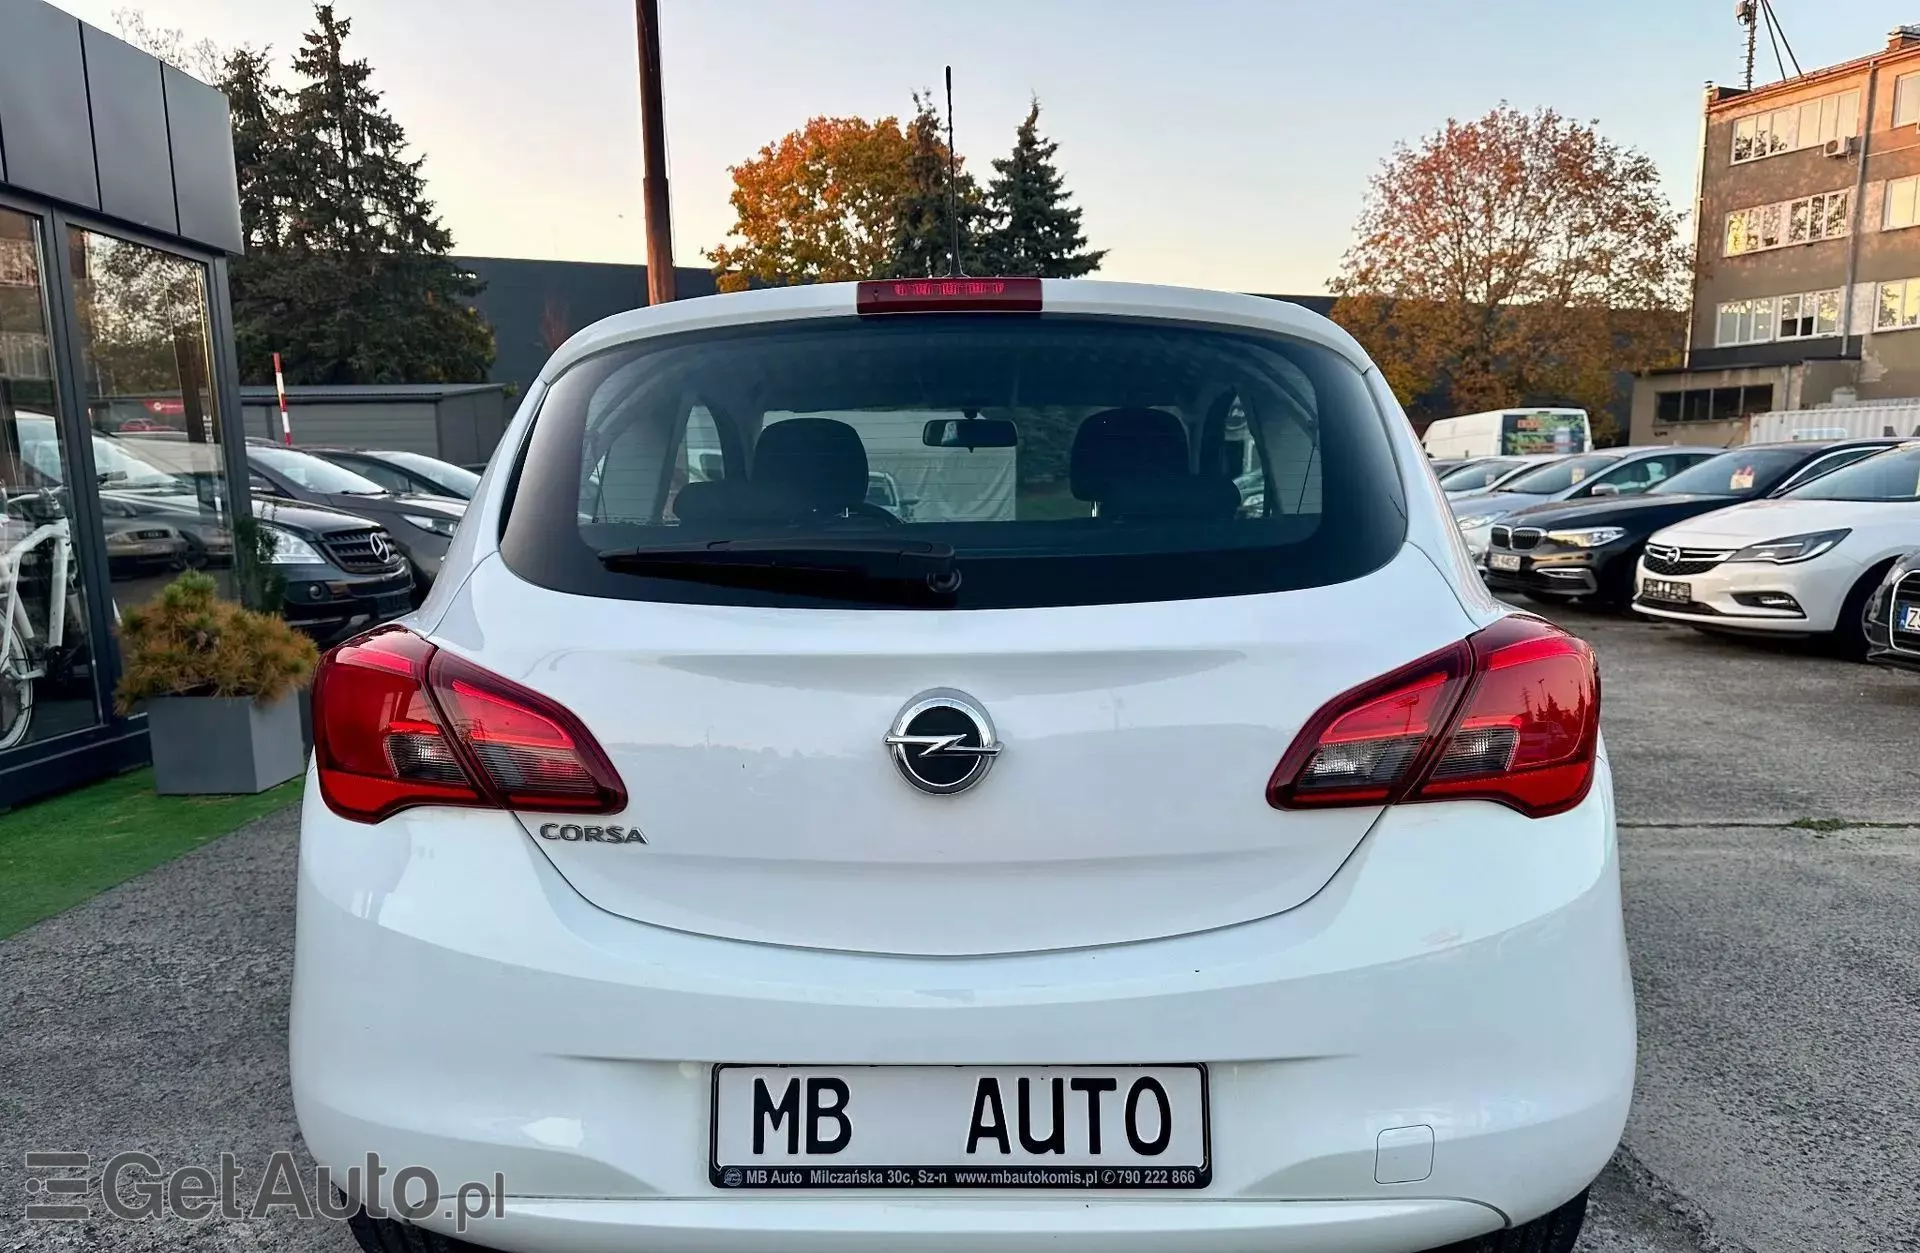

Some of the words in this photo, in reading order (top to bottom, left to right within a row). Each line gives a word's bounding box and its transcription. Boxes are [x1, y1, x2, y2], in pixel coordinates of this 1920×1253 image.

[540, 823, 648, 844] CORSA
[752, 1077, 852, 1155] MB
[965, 1076, 1173, 1156] AUTO
[746, 1170, 768, 1184] MB
[770, 1170, 802, 1184] Auto
[810, 1169, 883, 1184] Milczańska
[887, 1170, 914, 1186] 30c,
[918, 1169, 947, 1184] Sz-n
[955, 1169, 1098, 1187] www.mbautokomis.pl
[1116, 1170, 1141, 1184] 790
[1144, 1170, 1168, 1184] 222
[1171, 1170, 1196, 1184] 866
